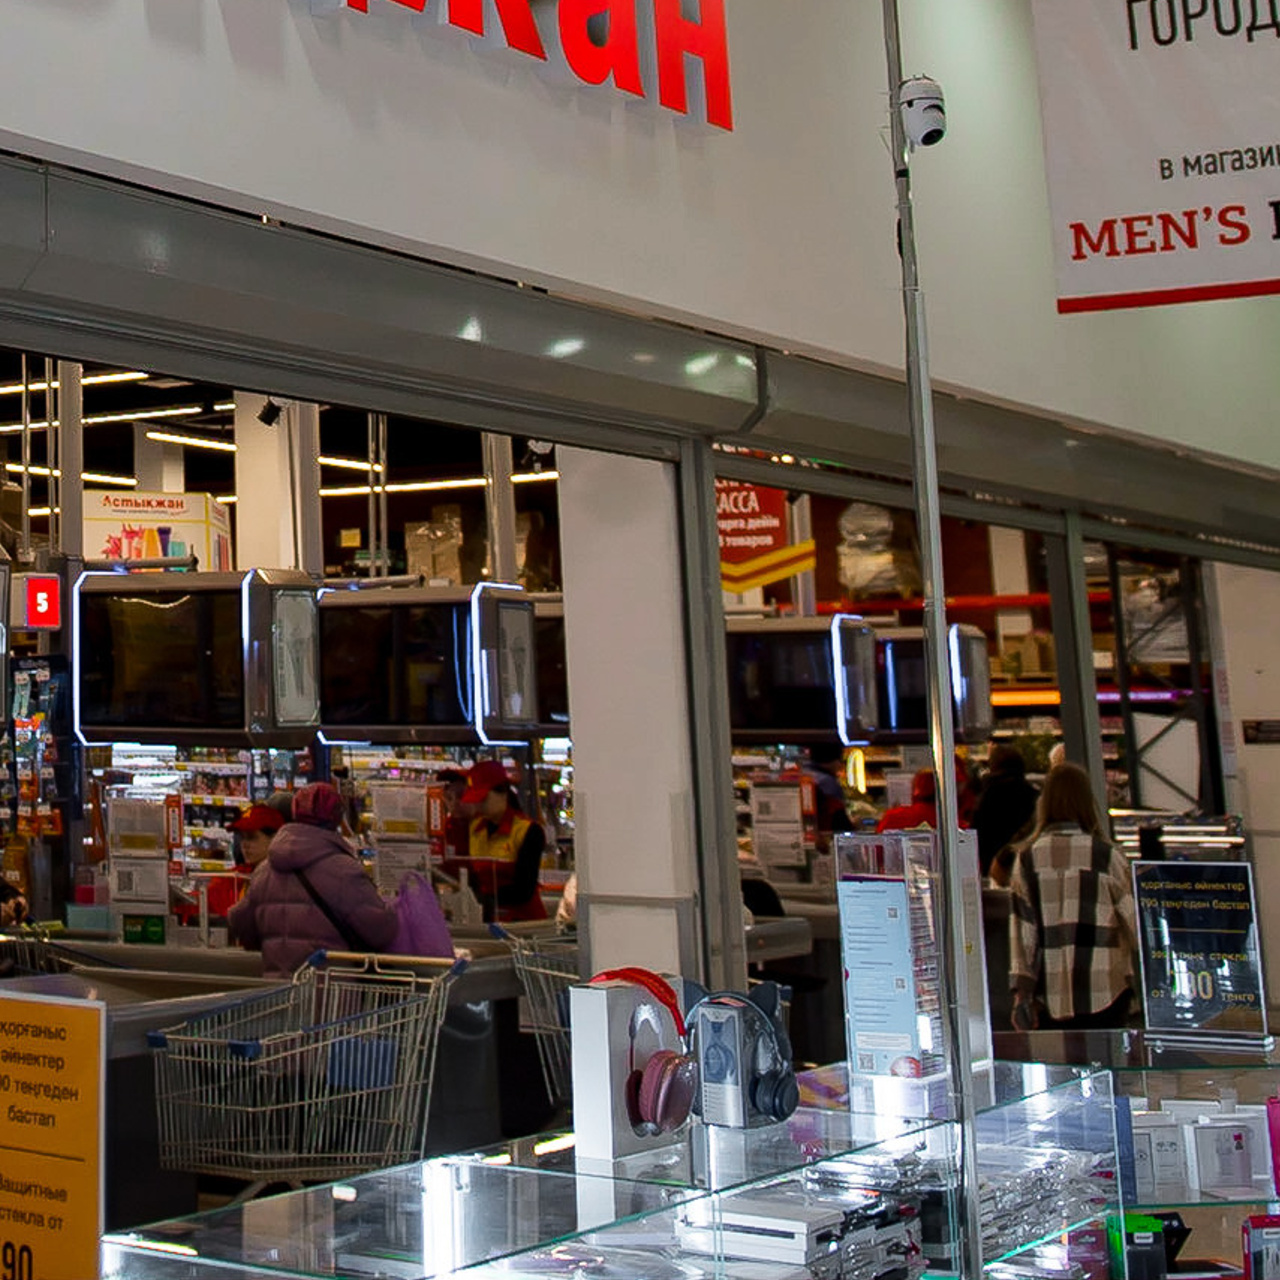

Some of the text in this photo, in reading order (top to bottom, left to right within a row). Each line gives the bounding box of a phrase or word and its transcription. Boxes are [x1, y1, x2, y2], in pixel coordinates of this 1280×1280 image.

[1160, 158, 1174, 180] в
[1069, 205, 1251, 261] MEN'S
[36, 592, 48, 613] 5
[0, 1021, 67, 1041] қорғаныс
[1, 1047, 65, 1072] әйнектер
[15, 1080, 79, 1102] теңгеден
[7, 1104, 56, 1128] бастап
[48, 1216, 64, 1230] от
